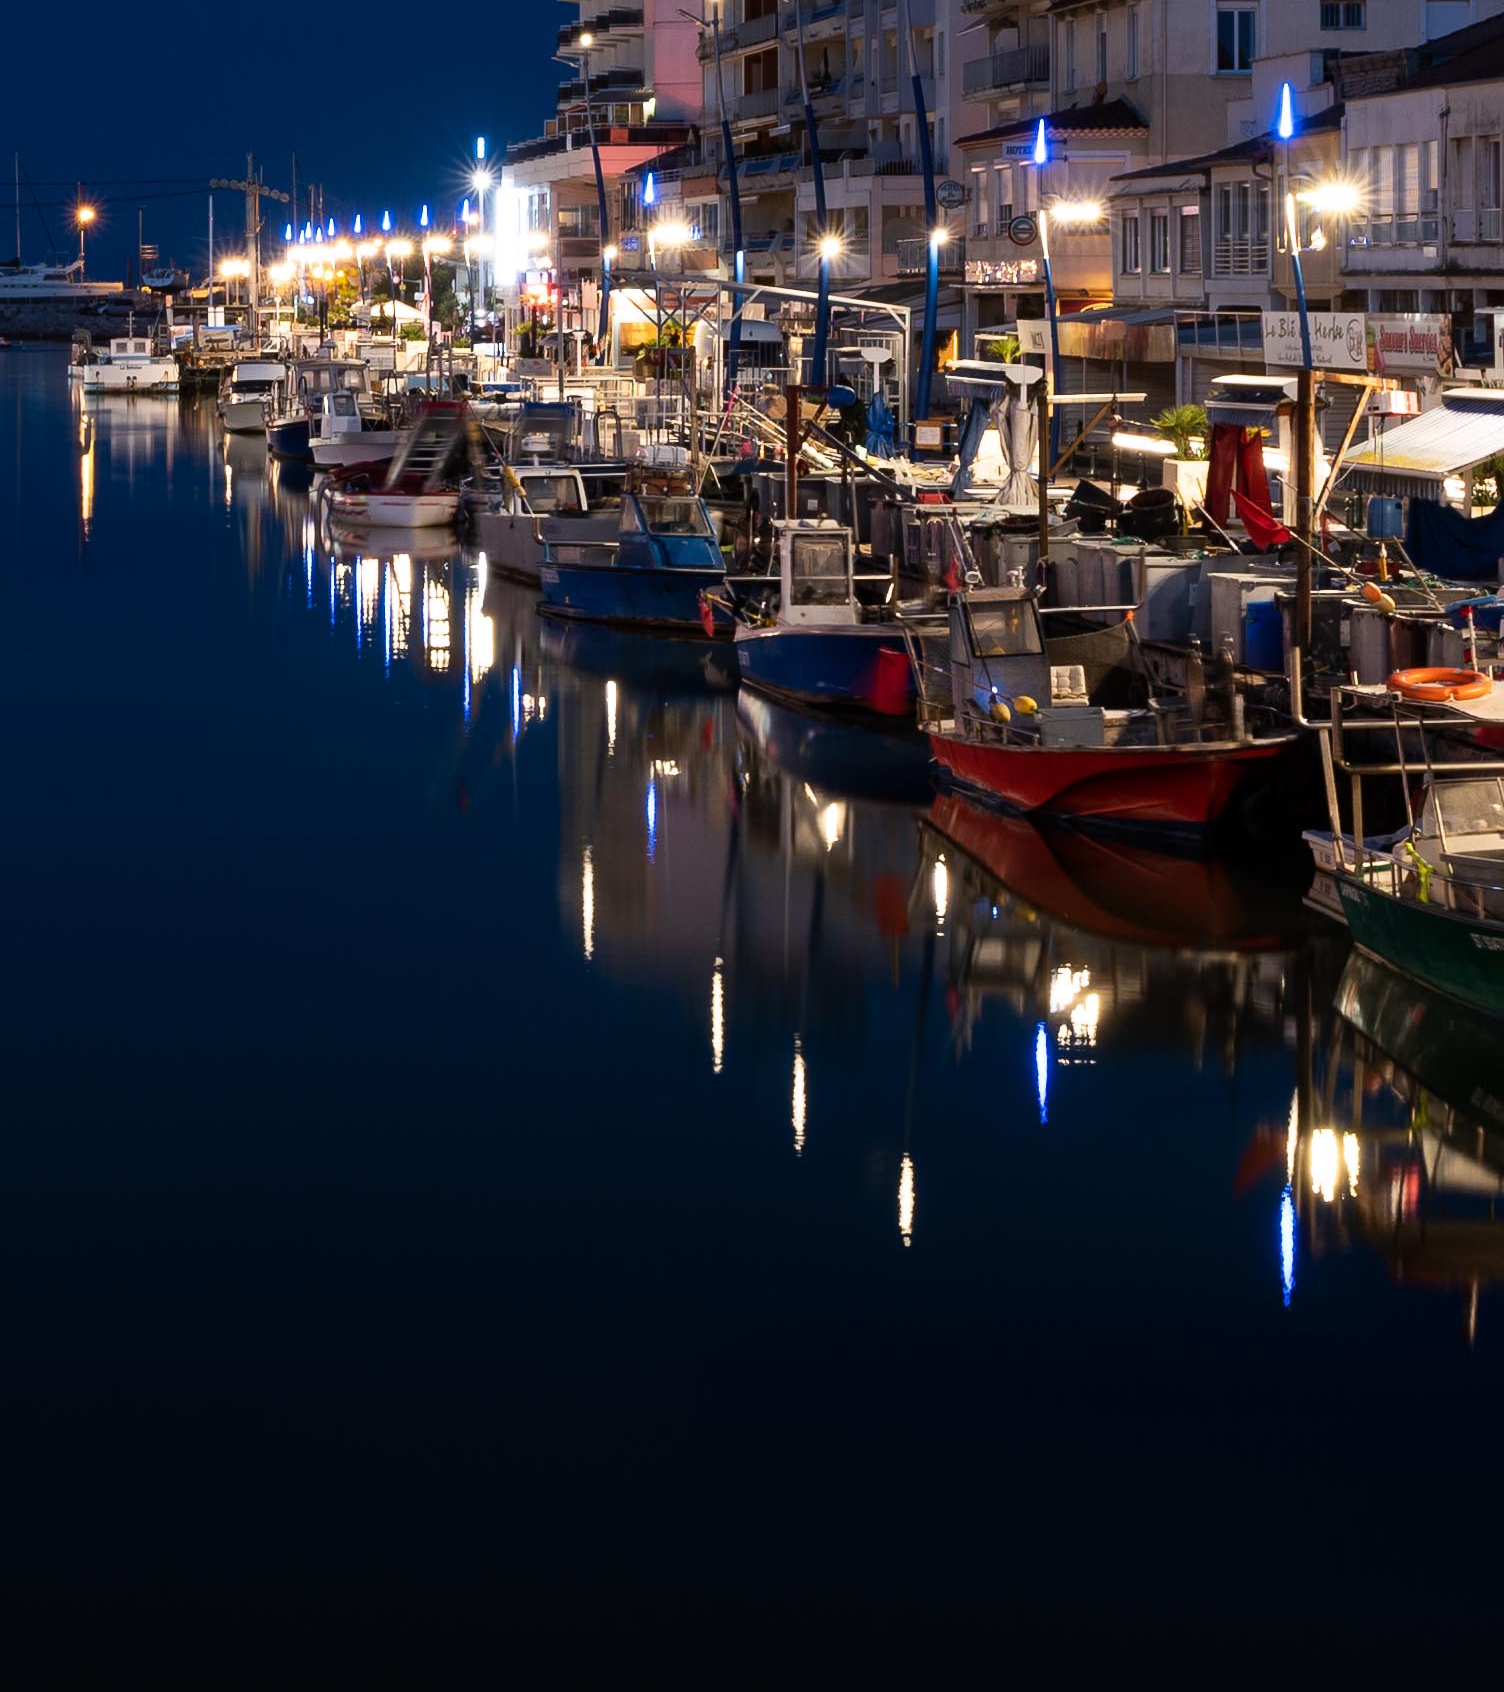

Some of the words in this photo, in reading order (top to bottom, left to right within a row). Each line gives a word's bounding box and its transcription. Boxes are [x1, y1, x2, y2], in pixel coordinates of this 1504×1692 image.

[1006, 145, 1032, 155] HOTEL
[1265, 317, 1276, 339] Le
[1278, 316, 1296, 339] Blé
[1314, 315, 1344, 342] Herbe
